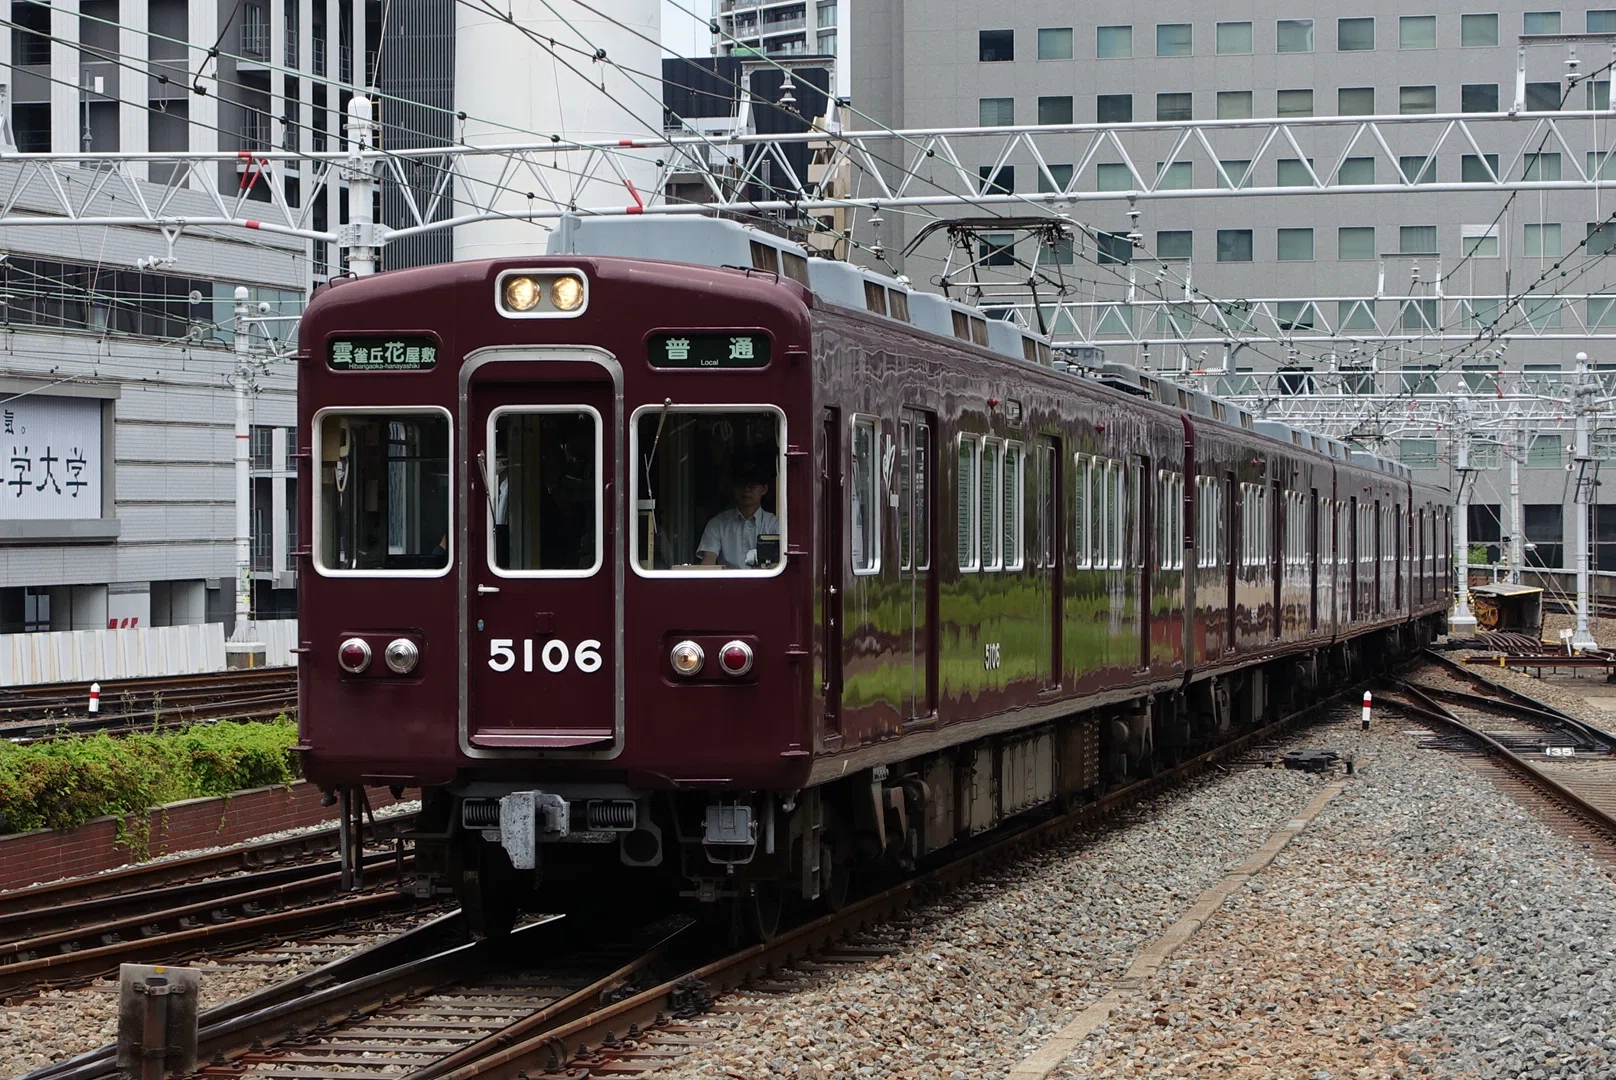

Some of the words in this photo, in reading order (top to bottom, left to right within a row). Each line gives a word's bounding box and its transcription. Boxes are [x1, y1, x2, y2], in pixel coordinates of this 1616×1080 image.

[333, 341, 436, 363] 雲雀丘花屋敷
[0, 446, 88, 498] 学大学
[488, 639, 602, 673] 5106
[985, 642, 1000, 670] 5106
